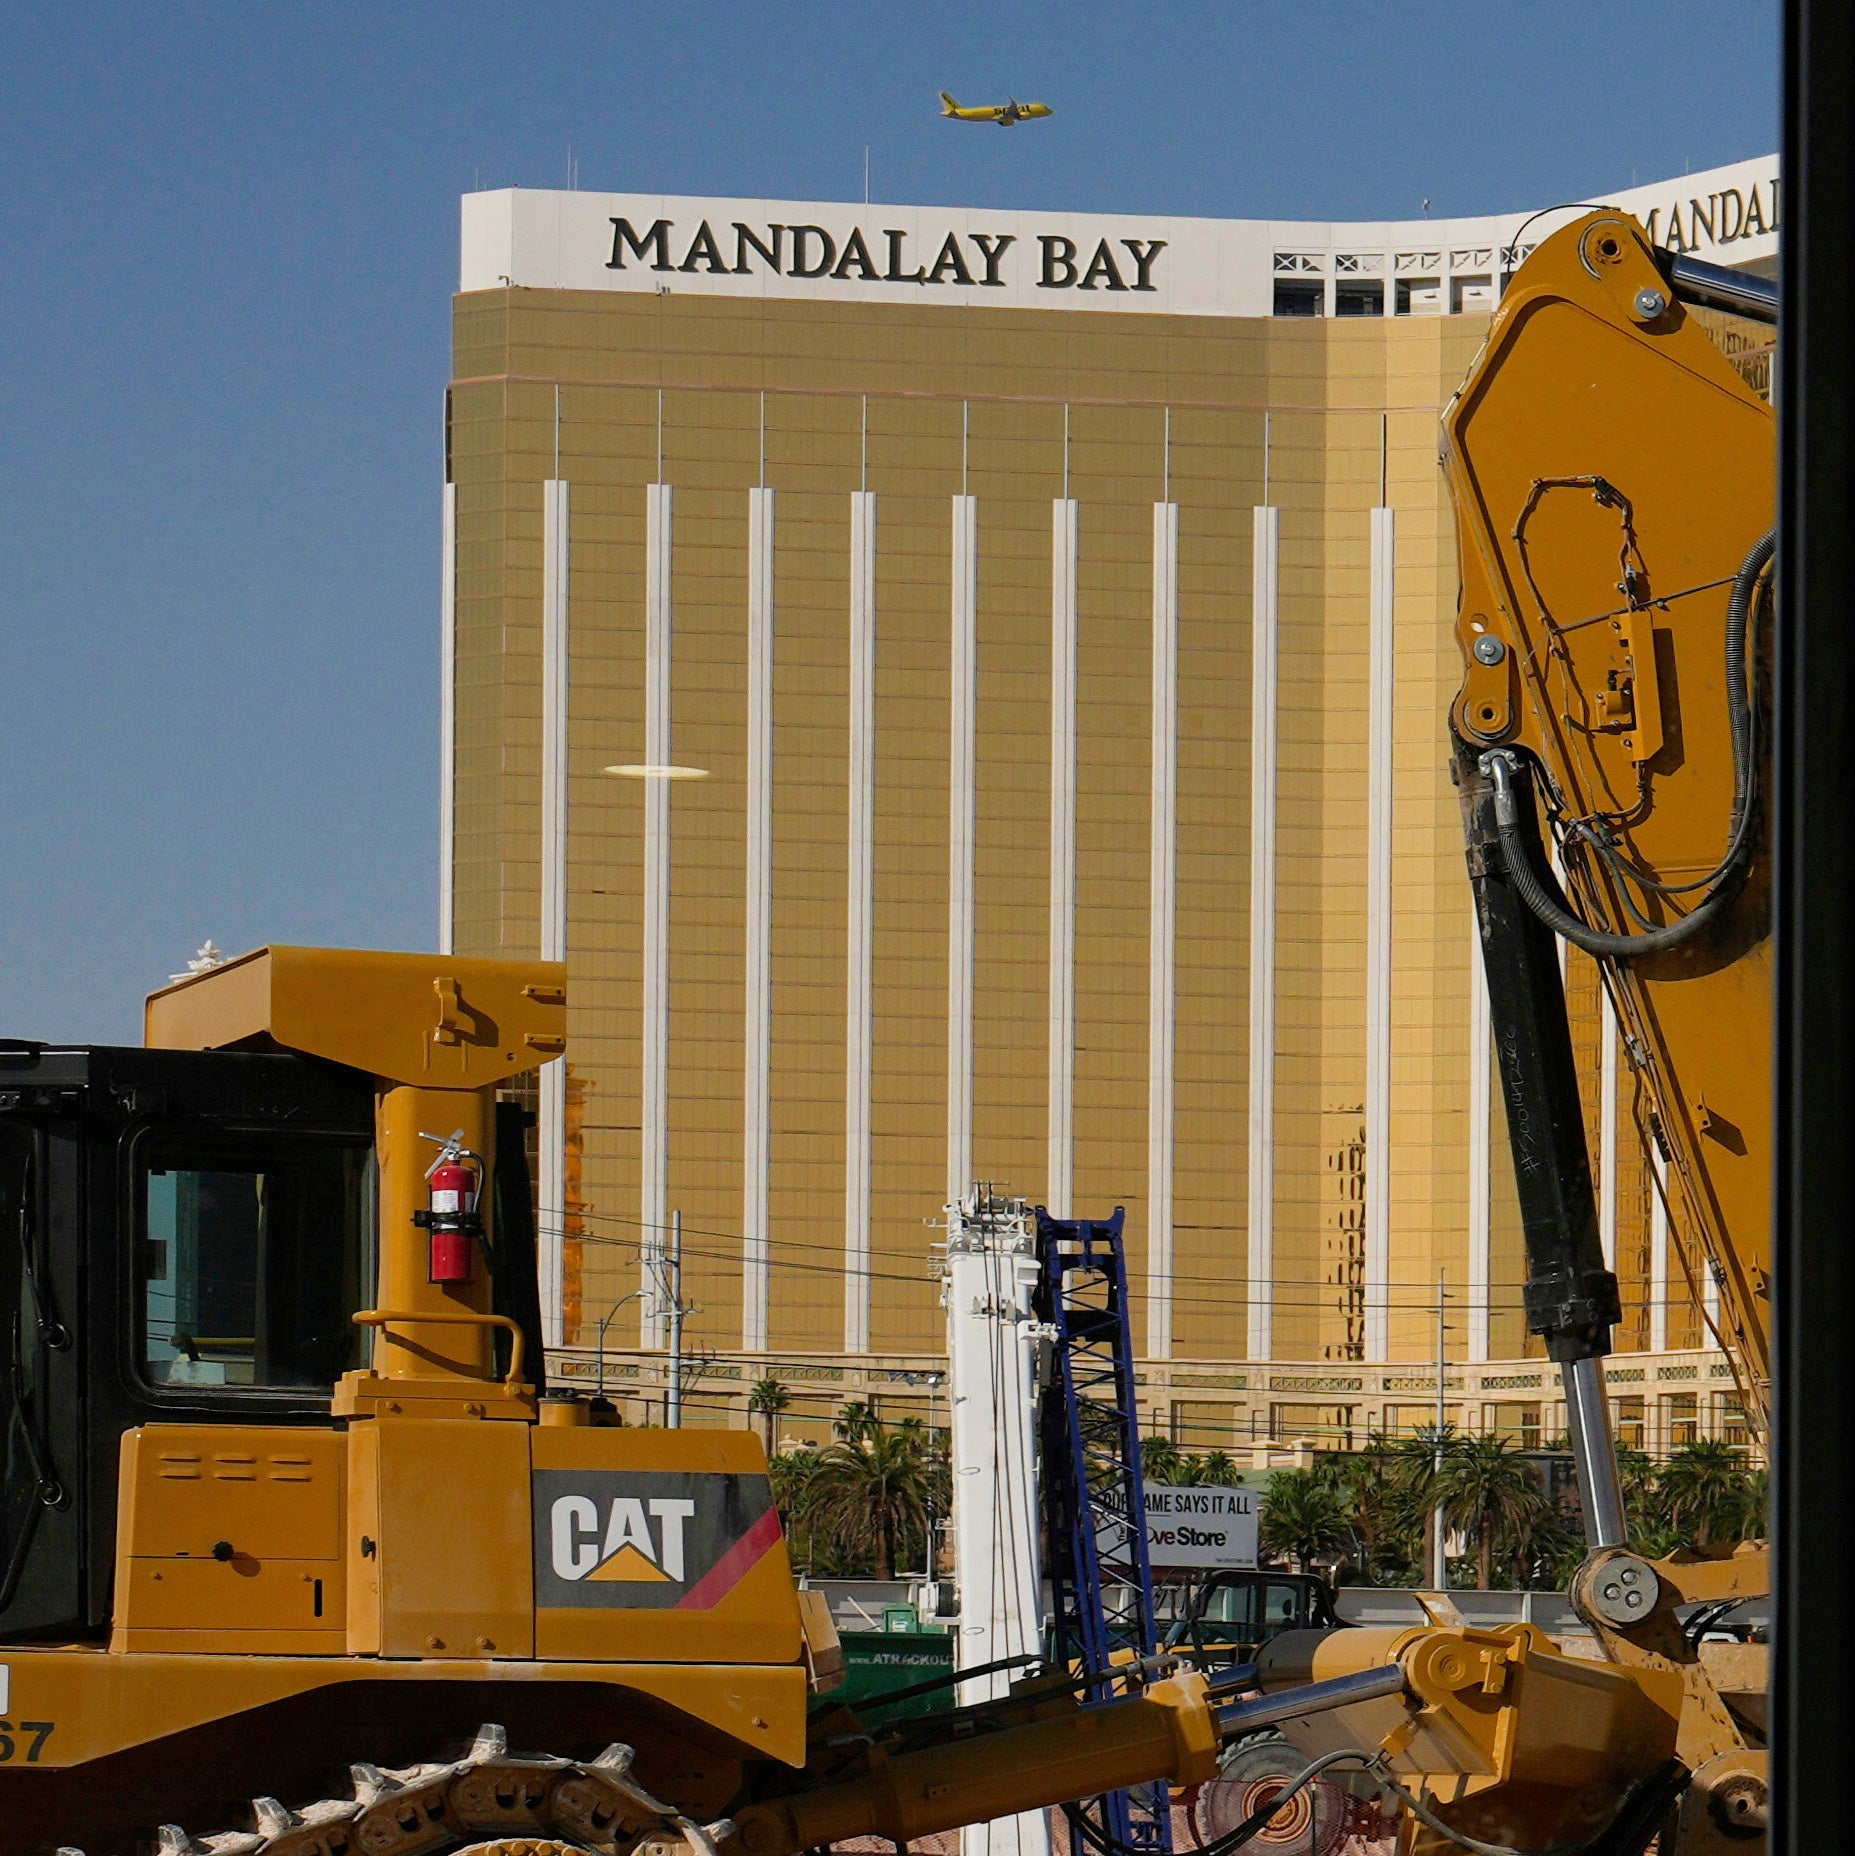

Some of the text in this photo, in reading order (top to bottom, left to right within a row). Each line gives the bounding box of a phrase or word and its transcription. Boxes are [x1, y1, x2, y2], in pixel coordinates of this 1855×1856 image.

[606, 217, 1168, 291] MANDALAY BAY
[1143, 1494, 1171, 1512] AME
[1175, 1495, 1208, 1513] SAYS
[1212, 1496, 1224, 1513] IT
[1227, 1497, 1251, 1514] ALL
[552, 1495, 695, 1583] CAT
[1177, 1527, 1227, 1547] Store
